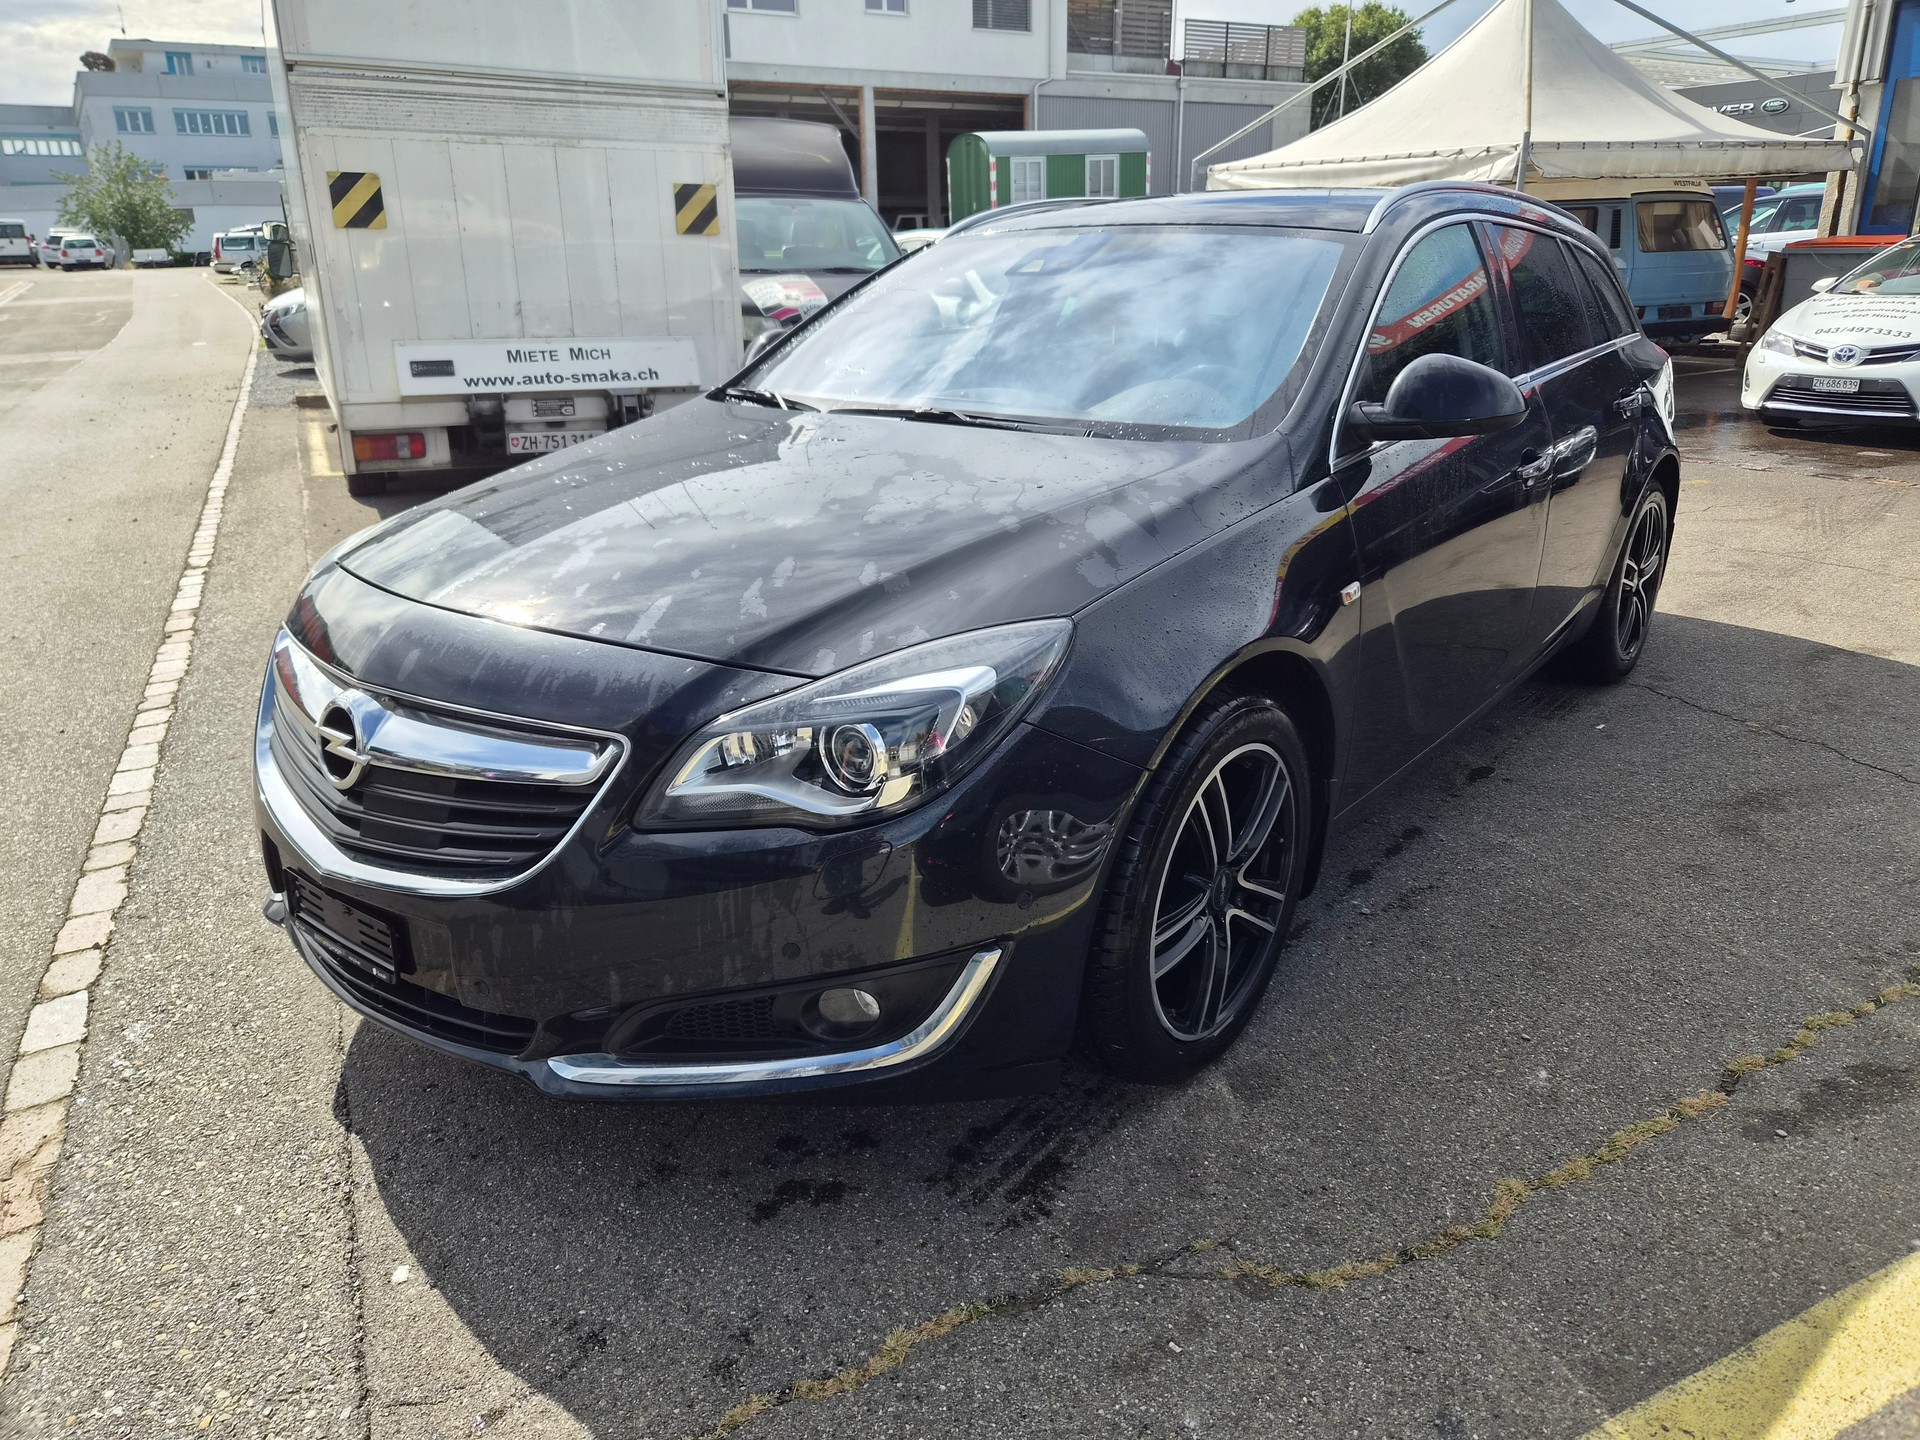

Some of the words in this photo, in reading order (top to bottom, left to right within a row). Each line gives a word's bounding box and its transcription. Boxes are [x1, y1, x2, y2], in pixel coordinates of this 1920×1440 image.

[1706, 103, 1754, 116] VER
[506, 349, 560, 364] MIETE
[569, 347, 612, 361] MICH
[463, 367, 660, 387] www.auto-smaka.ch
[1842, 380, 1859, 390] 839
